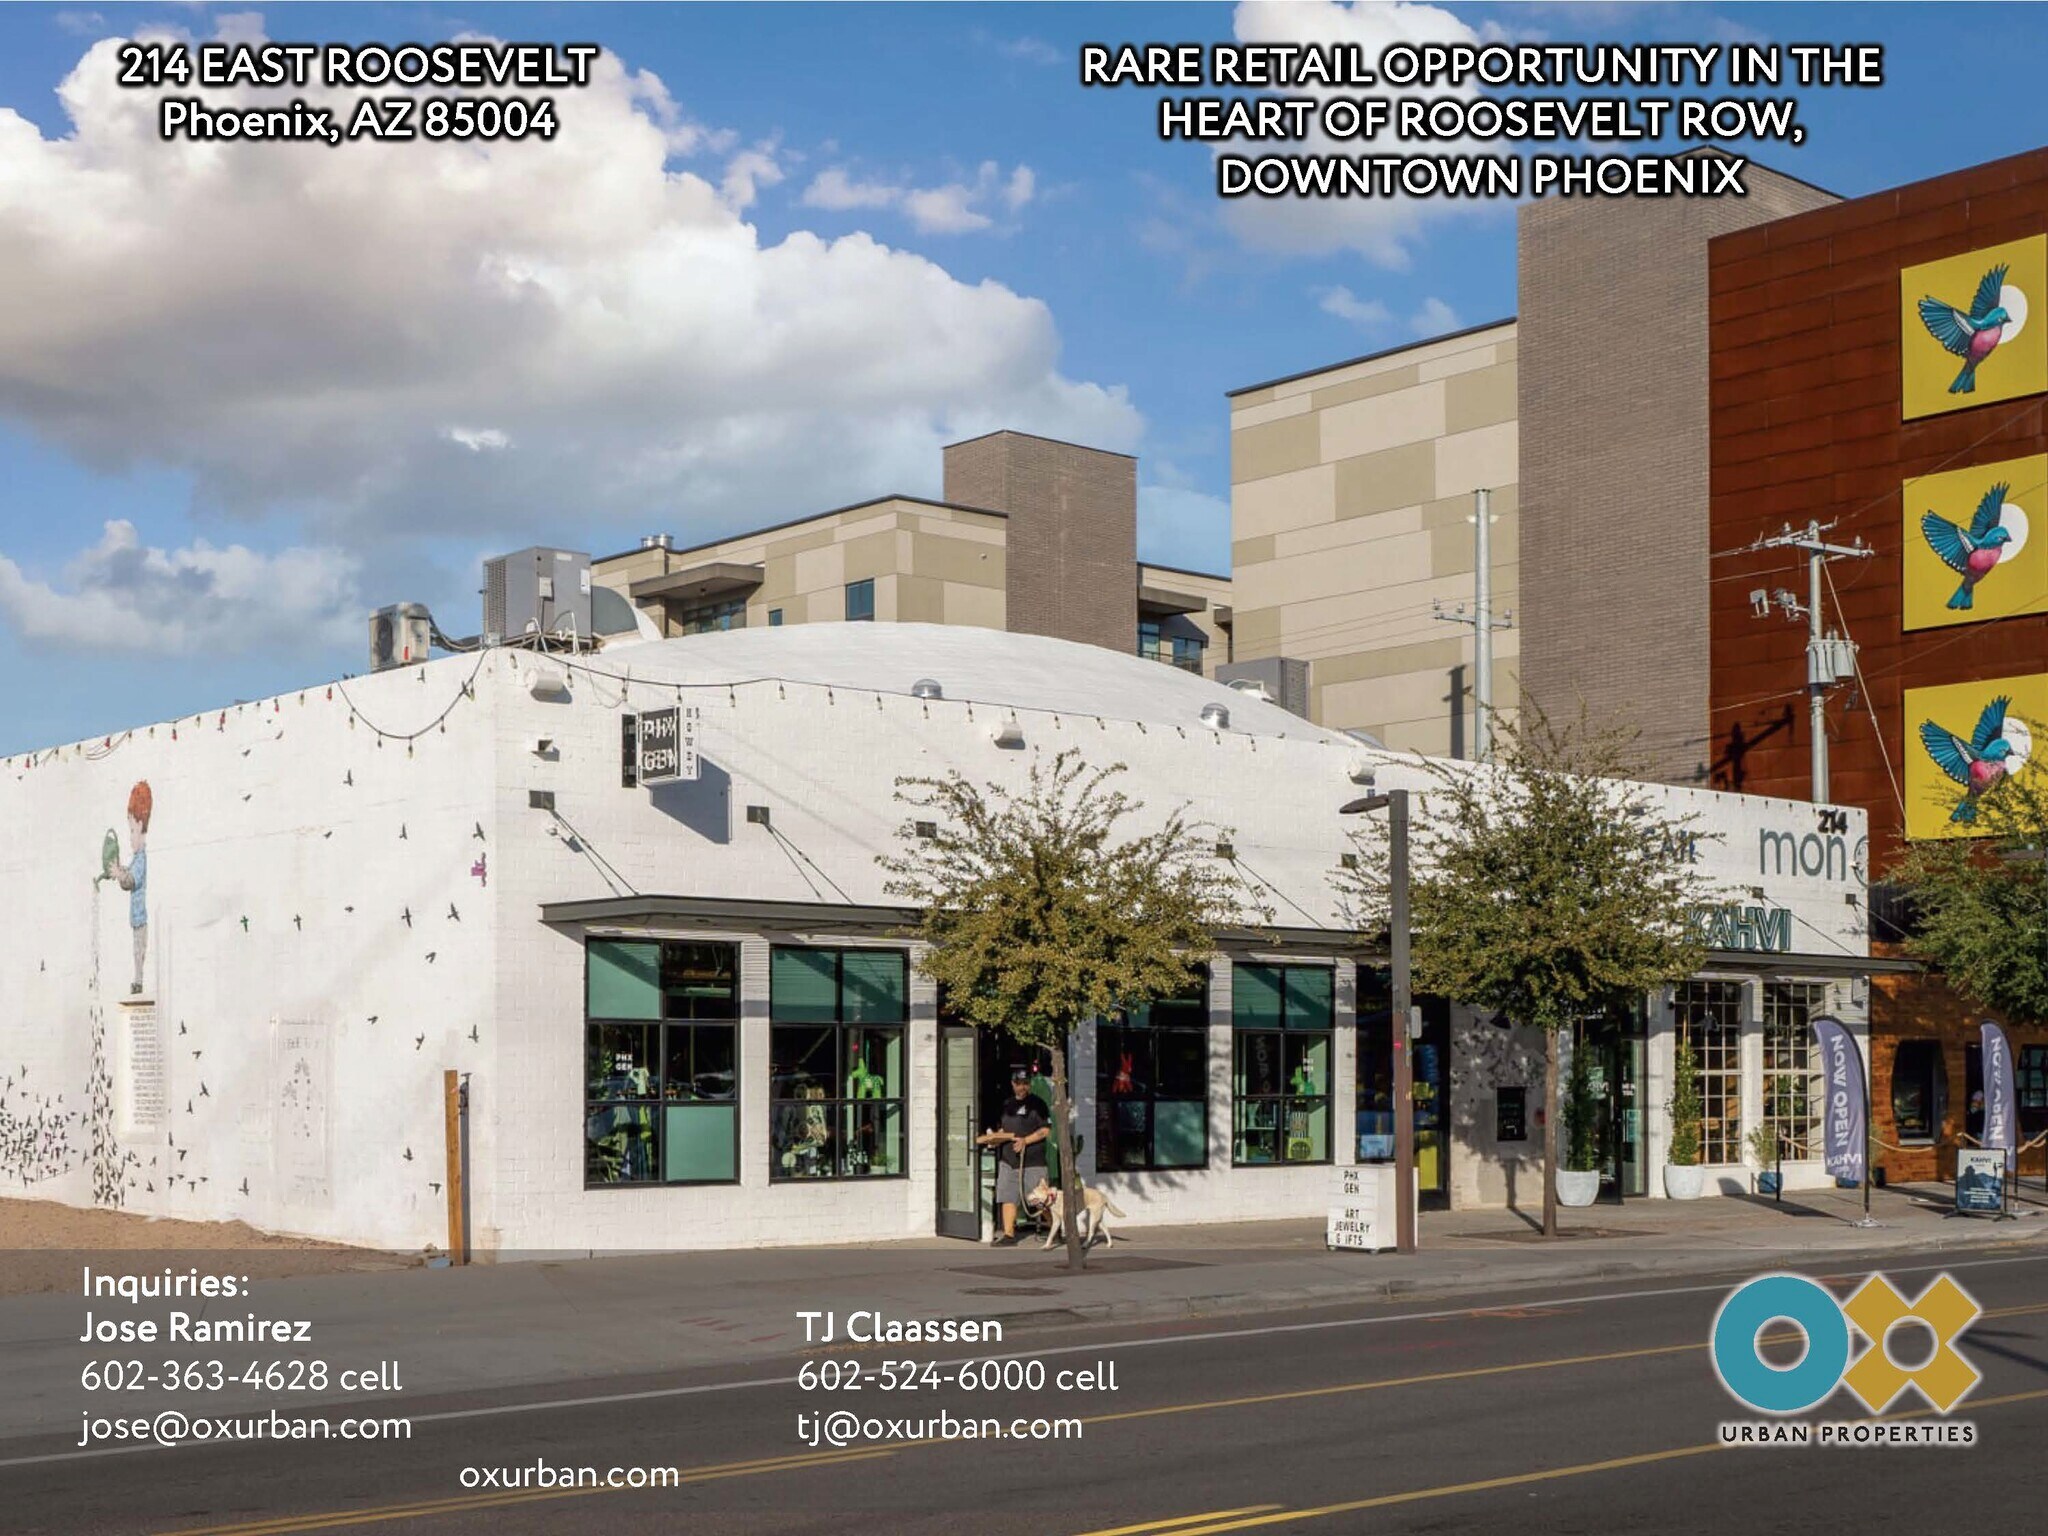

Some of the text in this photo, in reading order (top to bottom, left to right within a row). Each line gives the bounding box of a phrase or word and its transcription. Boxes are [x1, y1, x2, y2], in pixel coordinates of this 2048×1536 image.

[1818, 808, 1848, 835] 214
[1830, 1033, 1848, 1089] NOW
[1832, 1091, 1849, 1148] OPEN
[1334, 1221, 1370, 1234] JEWELRY
[1345, 1208, 1360, 1220] ART
